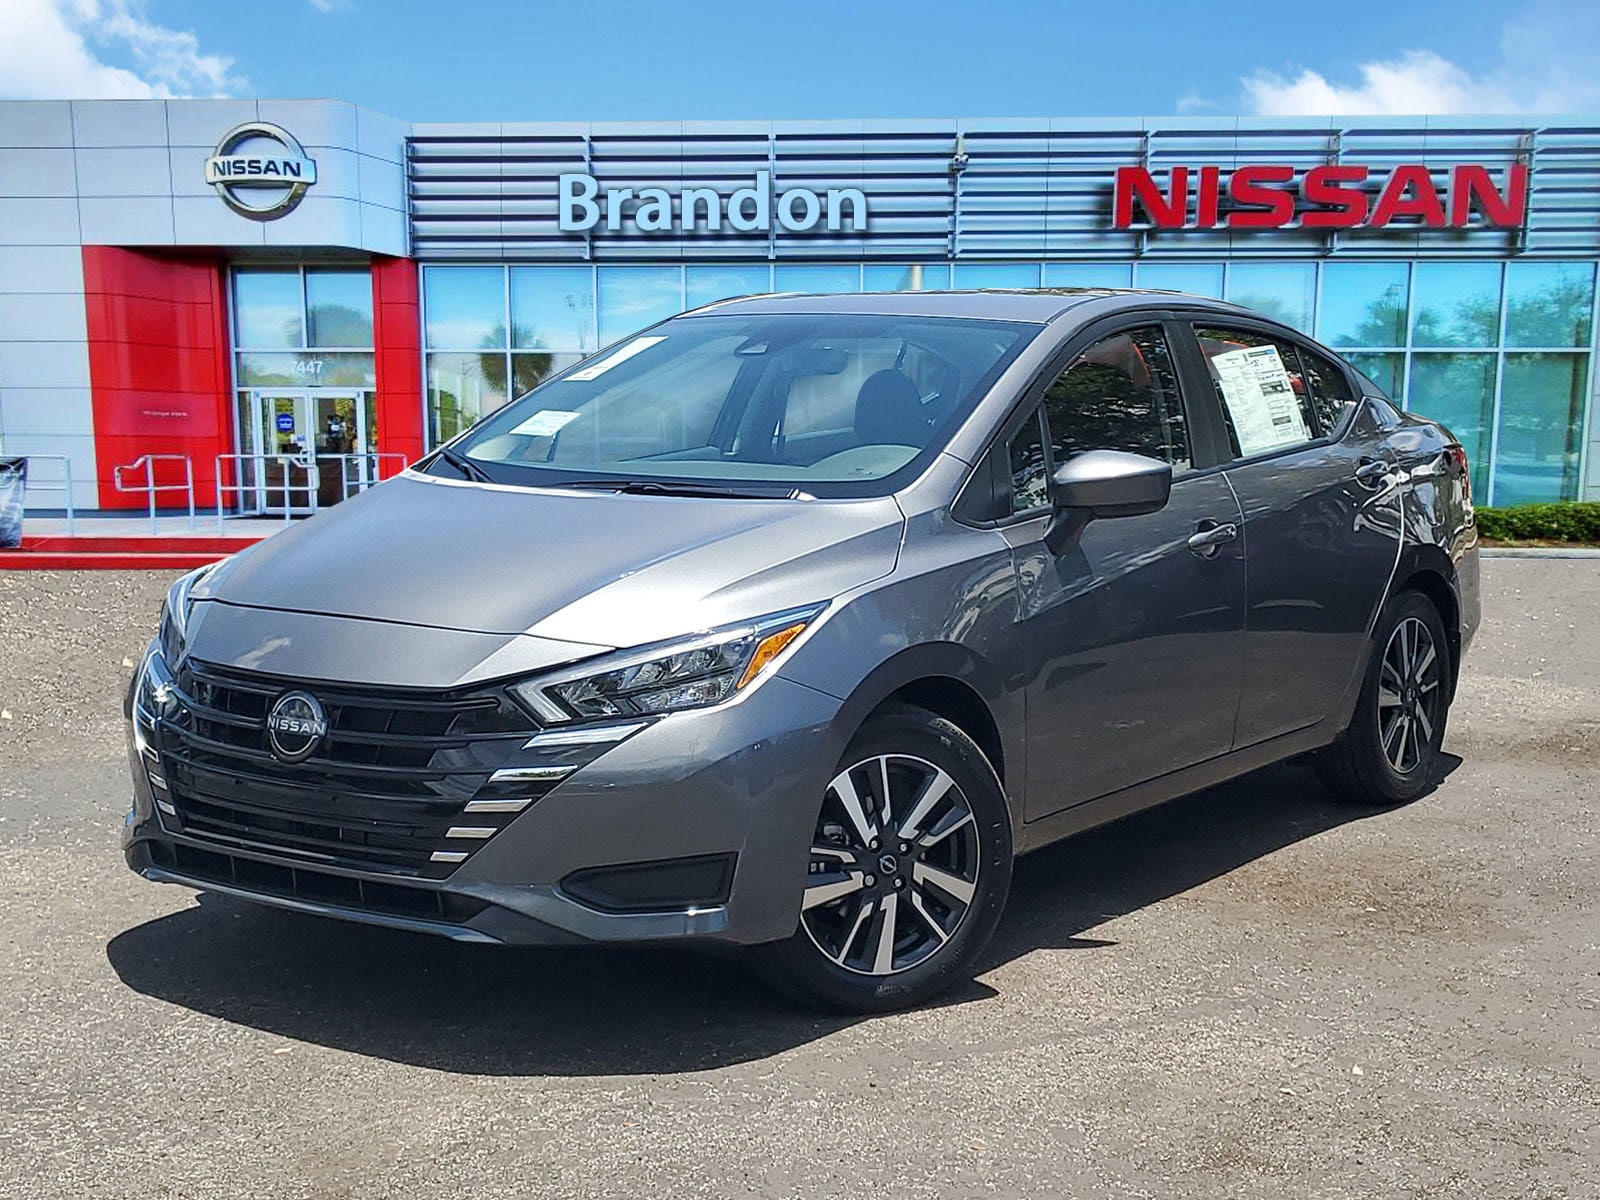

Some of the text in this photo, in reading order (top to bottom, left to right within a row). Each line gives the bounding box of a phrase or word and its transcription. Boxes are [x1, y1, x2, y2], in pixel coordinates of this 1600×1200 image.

[212, 159, 301, 177] NISSAN
[559, 170, 867, 232] Brandon
[1112, 164, 1528, 229] NISSAN
[267, 715, 326, 735] NISSAN
